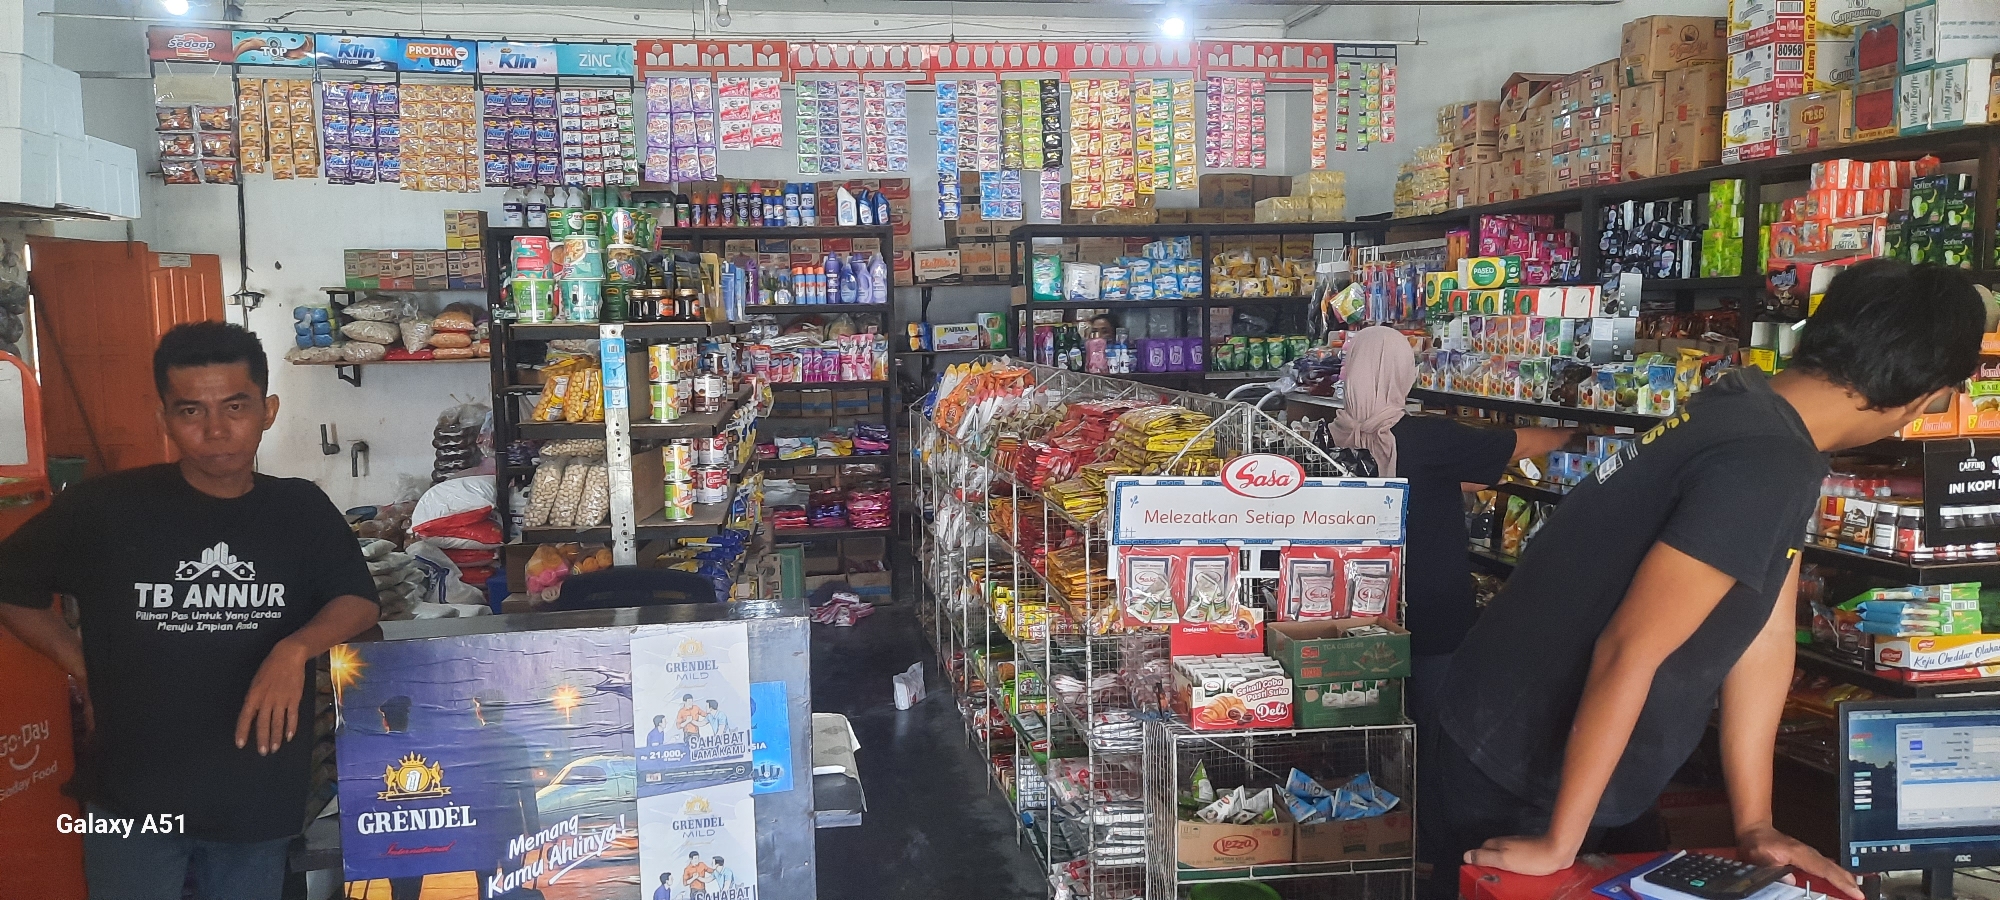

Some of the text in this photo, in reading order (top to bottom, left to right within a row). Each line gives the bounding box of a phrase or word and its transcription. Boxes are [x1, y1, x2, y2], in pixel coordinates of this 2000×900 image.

[168, 38, 216, 50] Sedaap
[1778, 44, 1802, 56] 80968
[262, 47, 287, 58] TOP
[337, 44, 375, 60] Klin
[408, 46, 454, 58] PRODUK
[434, 58, 458, 67] BARU
[498, 53, 538, 68] Klin
[1913, 181, 1934, 190] Softex
[1235, 460, 1291, 489] Sasa
[1948, 480, 1996, 494] INI KOPI
[1144, 508, 1376, 528] Melezatkan Setiap Masakan
[134, 582, 286, 608] TB ANNUR
[136, 610, 282, 621] Pilihan Pas Untuk Yang Cerdas
[157, 622, 194, 633] Menuju
[196, 622, 234, 632] Impian
[1914, 656, 1935, 668] Keju
[1938, 652, 1972, 665] Cheddar
[676, 672, 710, 682] MILD
[1236, 678, 1284, 697] Sekali Coba
[1246, 688, 1290, 702] Pasti Suka
[1256, 703, 1286, 718] Deli
[690, 732, 744, 750] SAHABAT
[692, 748, 718, 760] LAMA
[720, 745, 746, 756] KAMU
[508, 814, 579, 860] Memang
[682, 829, 716, 839] MILD
[1221, 839, 1252, 852] Lezza
[488, 860, 544, 899] Kamu
